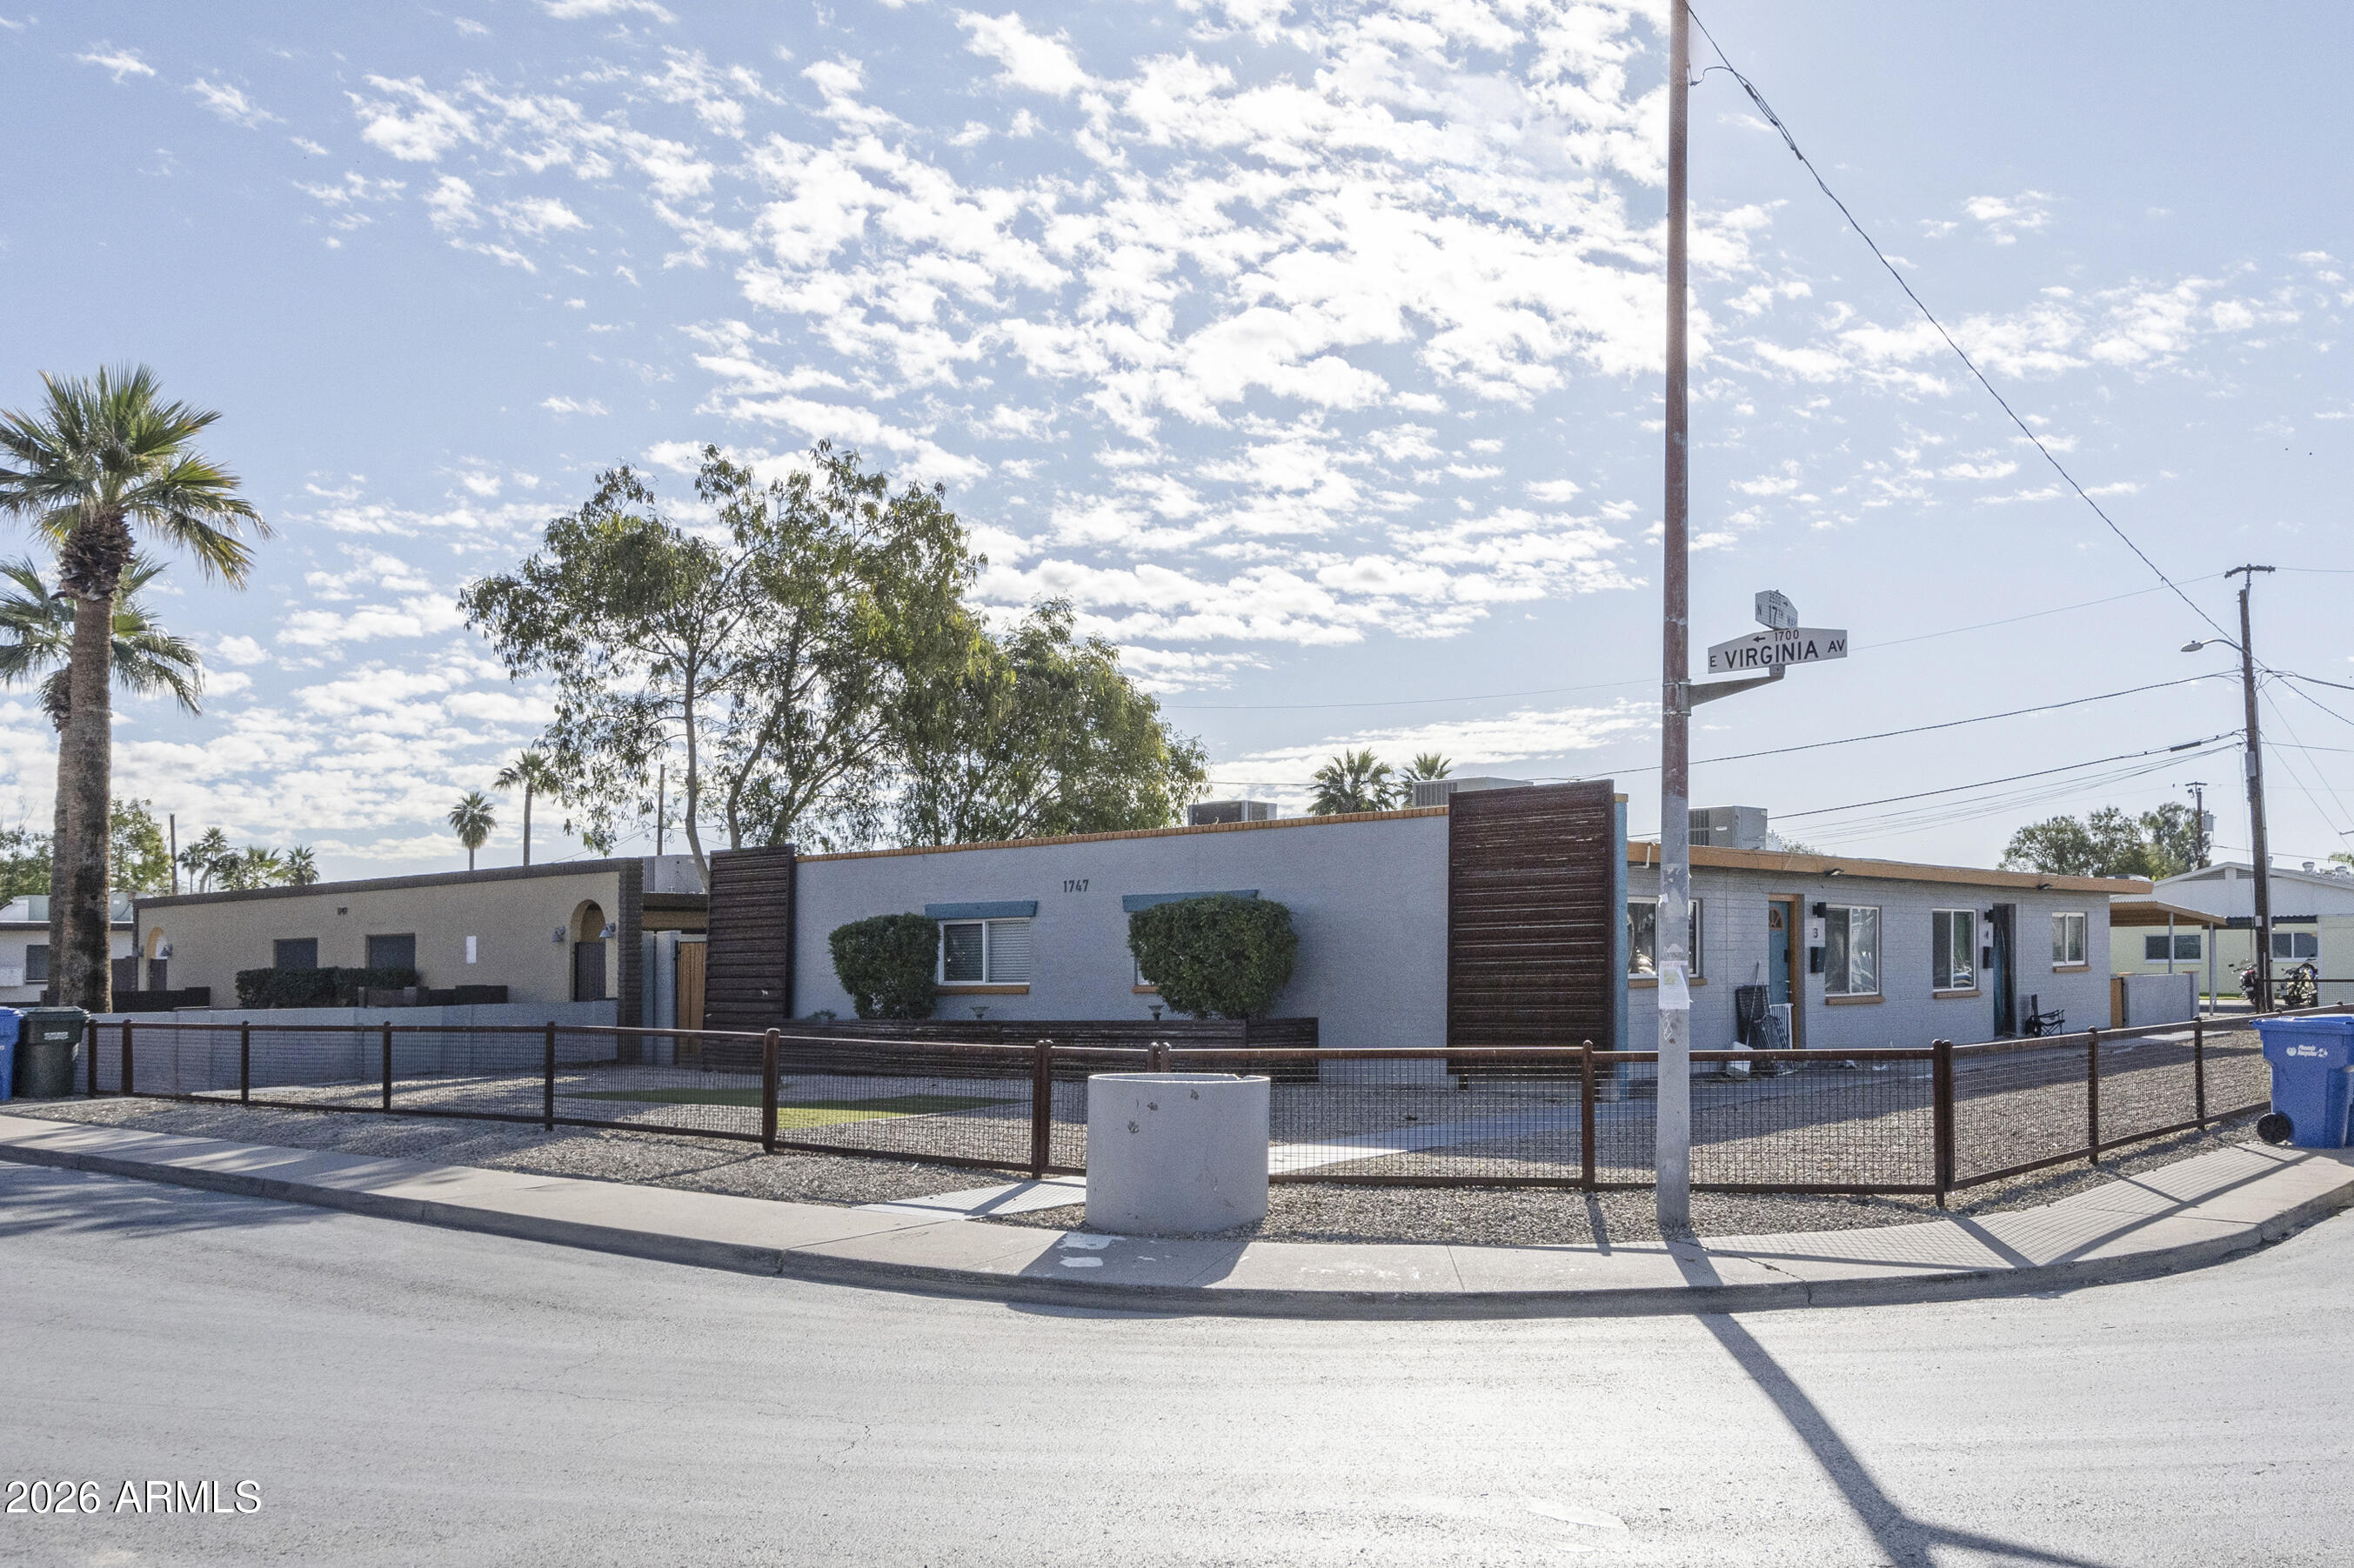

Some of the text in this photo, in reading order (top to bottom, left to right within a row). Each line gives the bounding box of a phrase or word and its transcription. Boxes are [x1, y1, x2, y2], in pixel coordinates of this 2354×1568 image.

[1775, 630, 1800, 642] 1700
[1709, 639, 1845, 669] E VIRGINIA AV
[1063, 879, 1089, 892] 1747
[1813, 927, 1818, 938] 3
